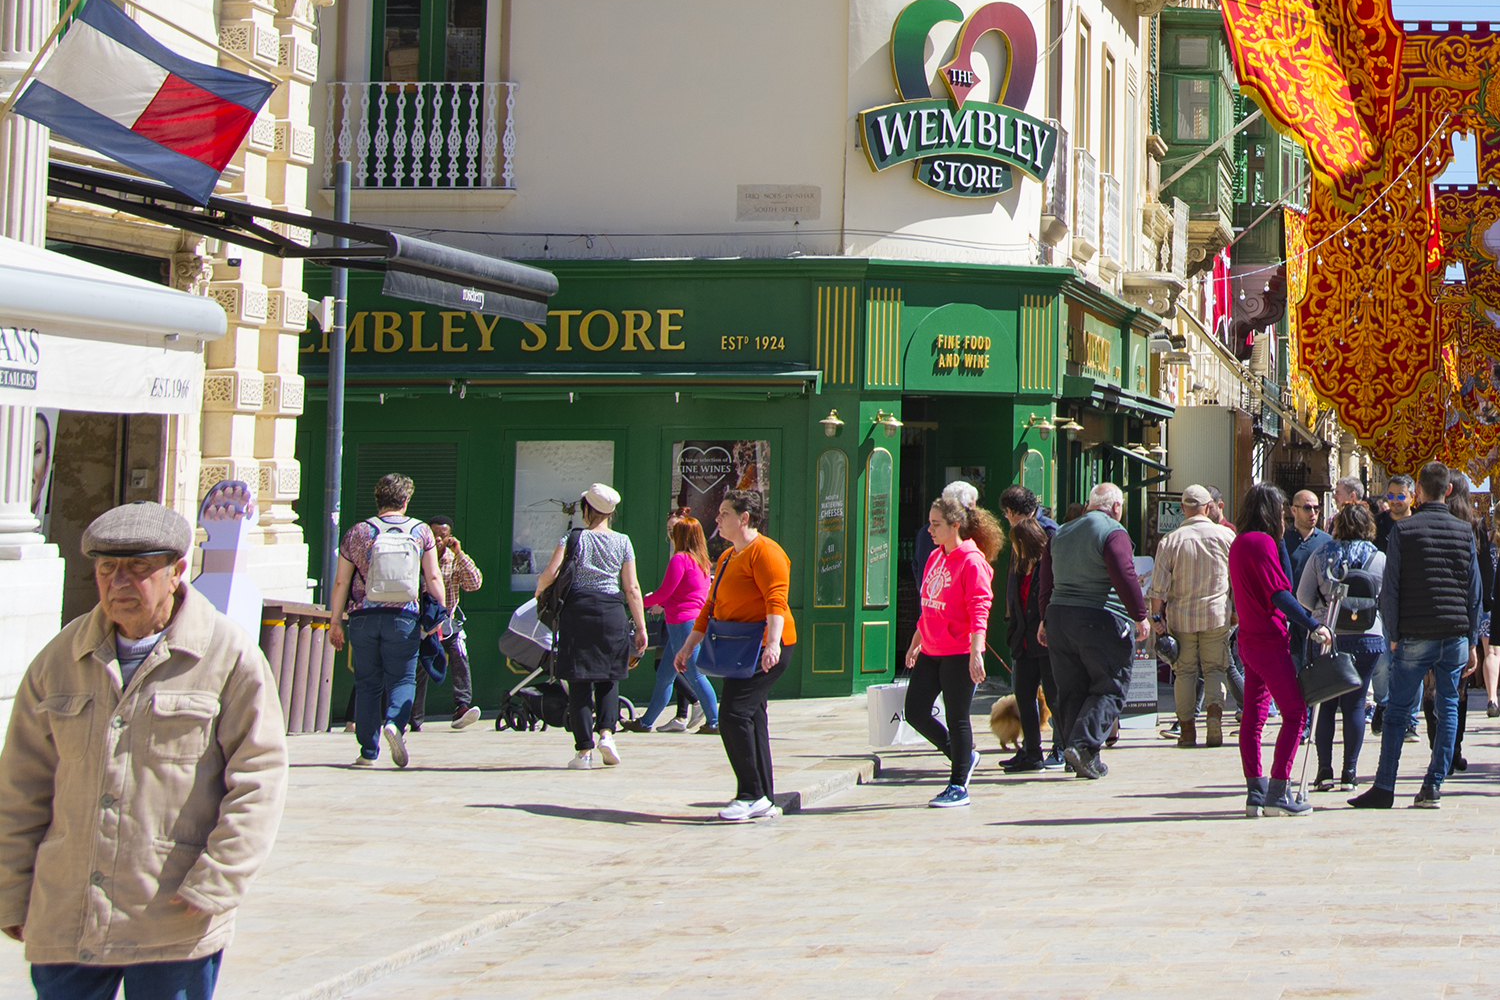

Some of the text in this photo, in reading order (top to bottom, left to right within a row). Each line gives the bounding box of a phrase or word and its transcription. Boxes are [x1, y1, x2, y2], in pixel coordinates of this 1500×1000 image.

[950, 68, 974, 84] THE
[877, 108, 1050, 170] WEMBLEY
[932, 160, 1003, 188] STORE
[521, 309, 686, 351] STORE
[755, 336, 785, 350] 1924
[937, 334, 991, 350] FINE FOOD
[938, 354, 990, 368] AND WINE
[821, 508, 843, 518] CHEESES
